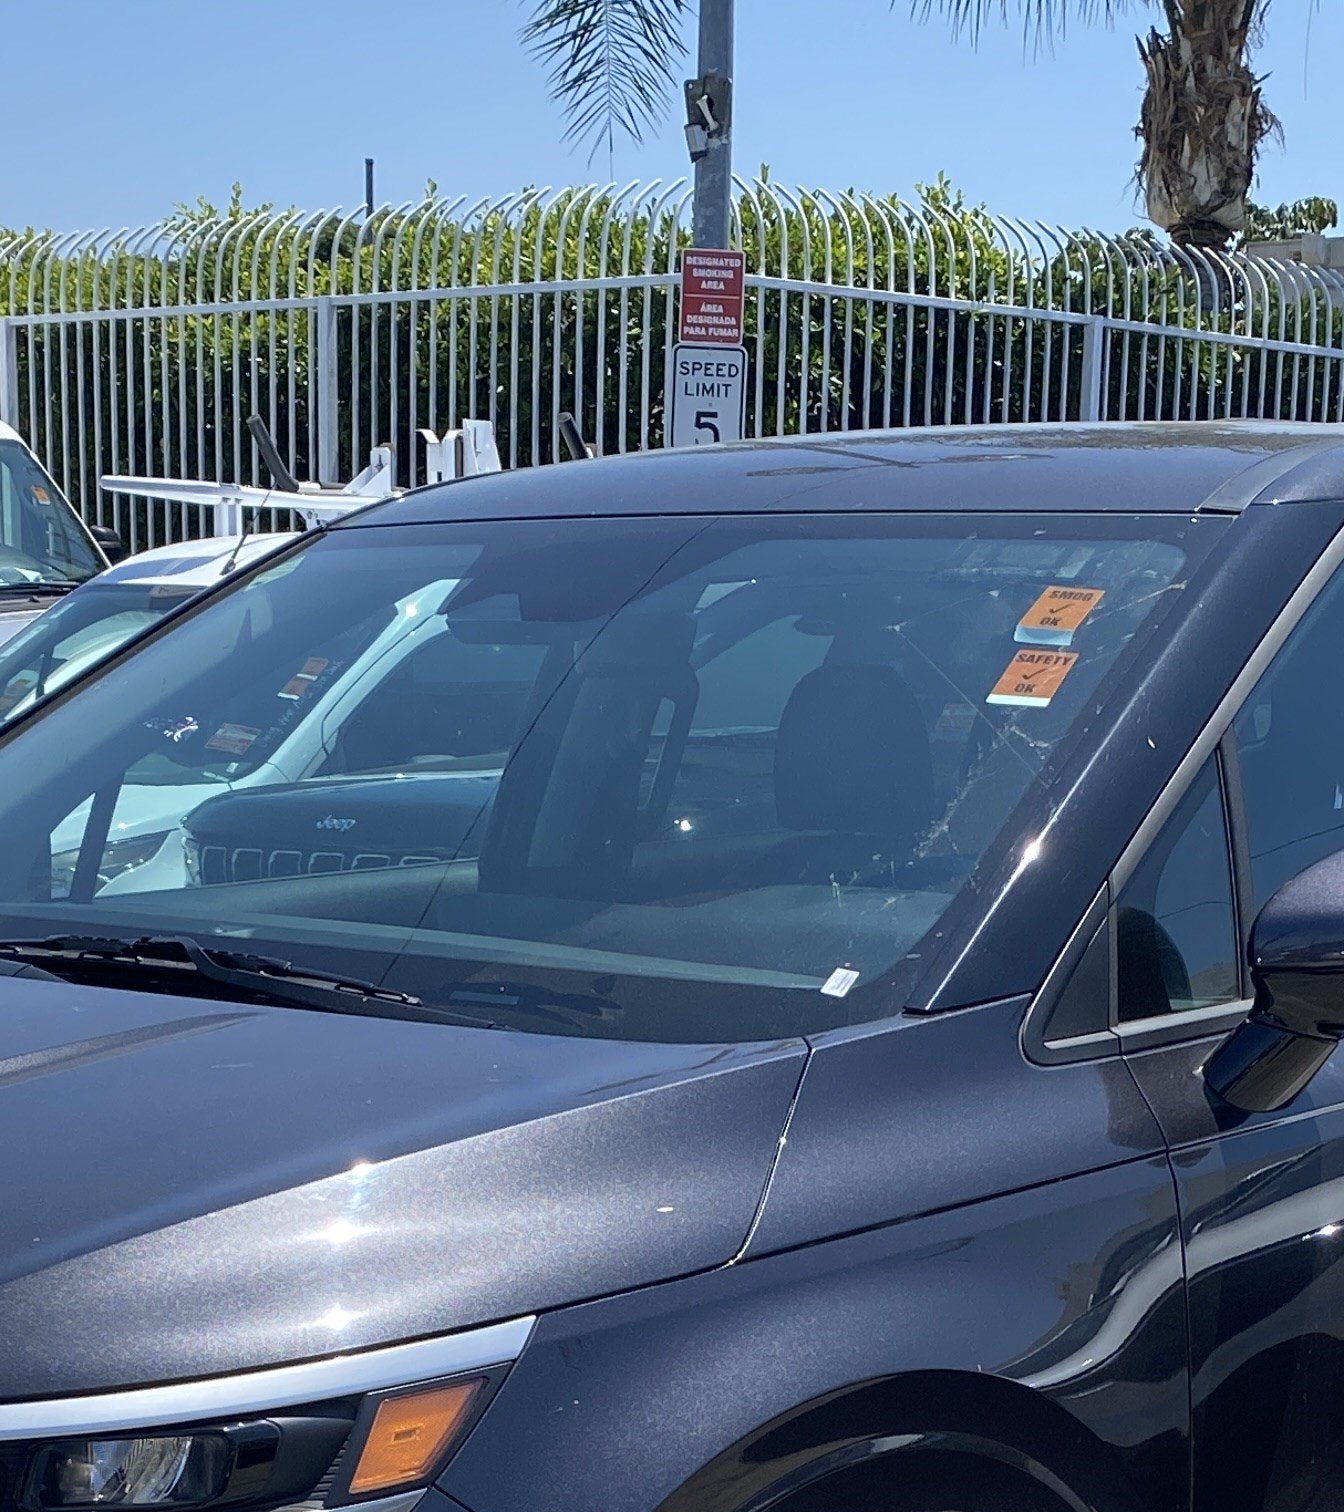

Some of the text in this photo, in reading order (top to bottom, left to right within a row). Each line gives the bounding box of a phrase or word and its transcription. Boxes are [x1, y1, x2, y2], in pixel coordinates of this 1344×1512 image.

[686, 256, 742, 267] DESIGNATED
[692, 268, 734, 279] SMOKING
[700, 280, 725, 290] AREA
[686, 314, 737, 325] DESIGNADA
[683, 326, 739, 338] PARA FUMAR
[679, 361, 740, 378] SPEED
[684, 382, 732, 398] LIMIT
[694, 410, 720, 445] 5
[1049, 590, 1094, 602] SMOG
[1039, 617, 1060, 627] OK
[1015, 653, 1072, 666] SAFETY
[1014, 683, 1036, 694] OK
[316, 814, 356, 832] Jeep
